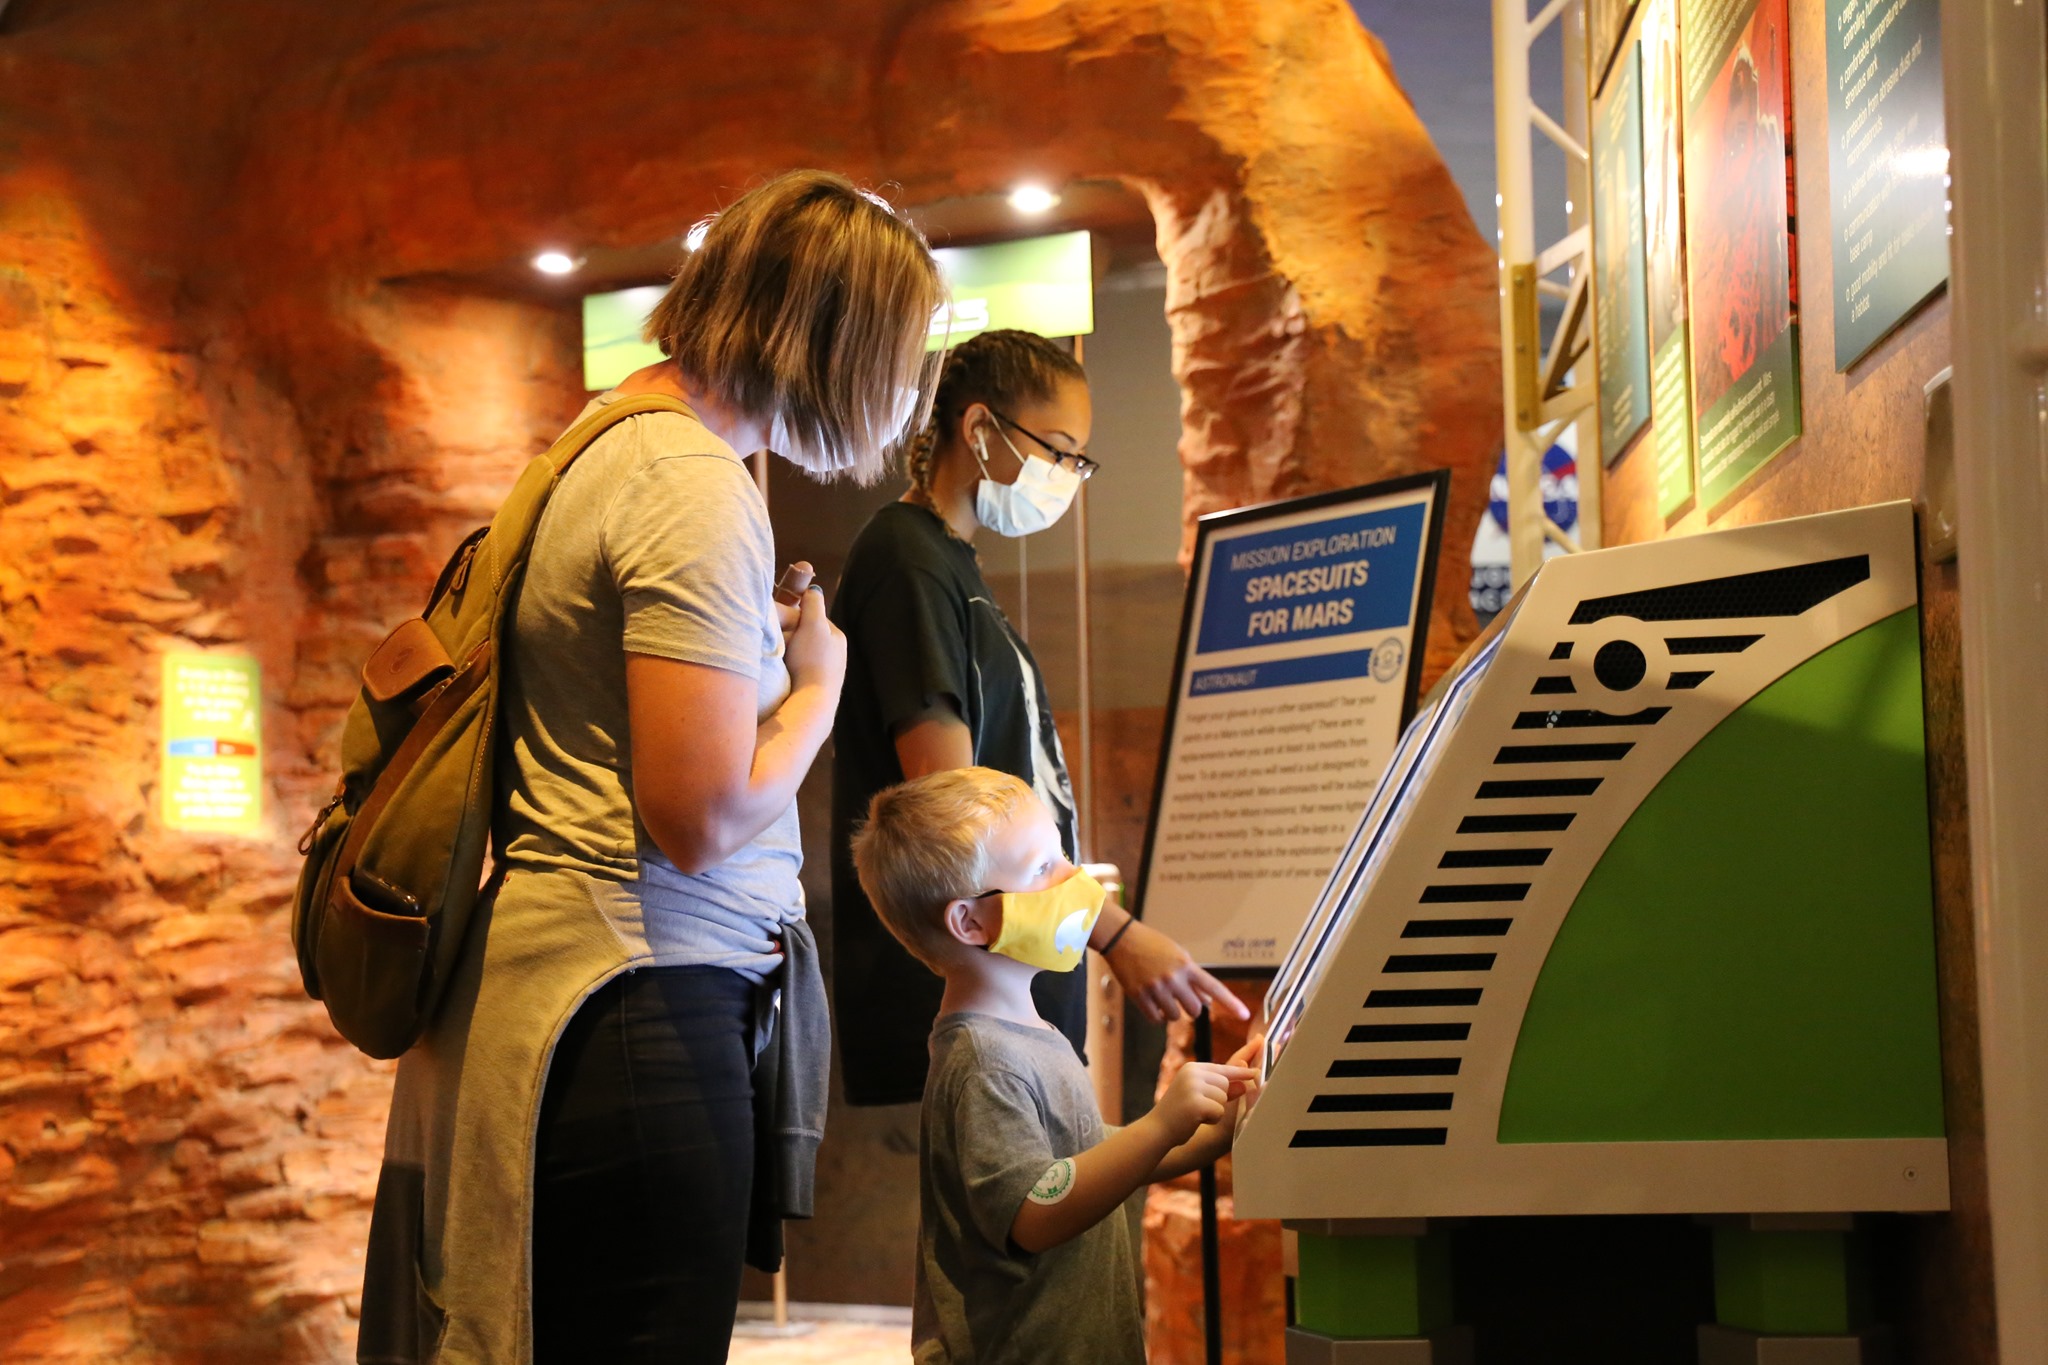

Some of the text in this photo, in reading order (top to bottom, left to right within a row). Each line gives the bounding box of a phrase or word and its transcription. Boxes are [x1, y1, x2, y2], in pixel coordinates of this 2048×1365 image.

[1845, 38, 1870, 83] comfortable
[1870, 1, 1899, 49] temperature
[1845, 53, 1879, 109] strenuous work
[1880, 67, 1899, 102] abrasive
[1230, 526, 1397, 572] MISSION EXPLORATION
[1244, 559, 1370, 604] SPACESUITS
[1247, 598, 1355, 638] FOR MARS
[1194, 668, 1258, 691] ASTRONAUT
